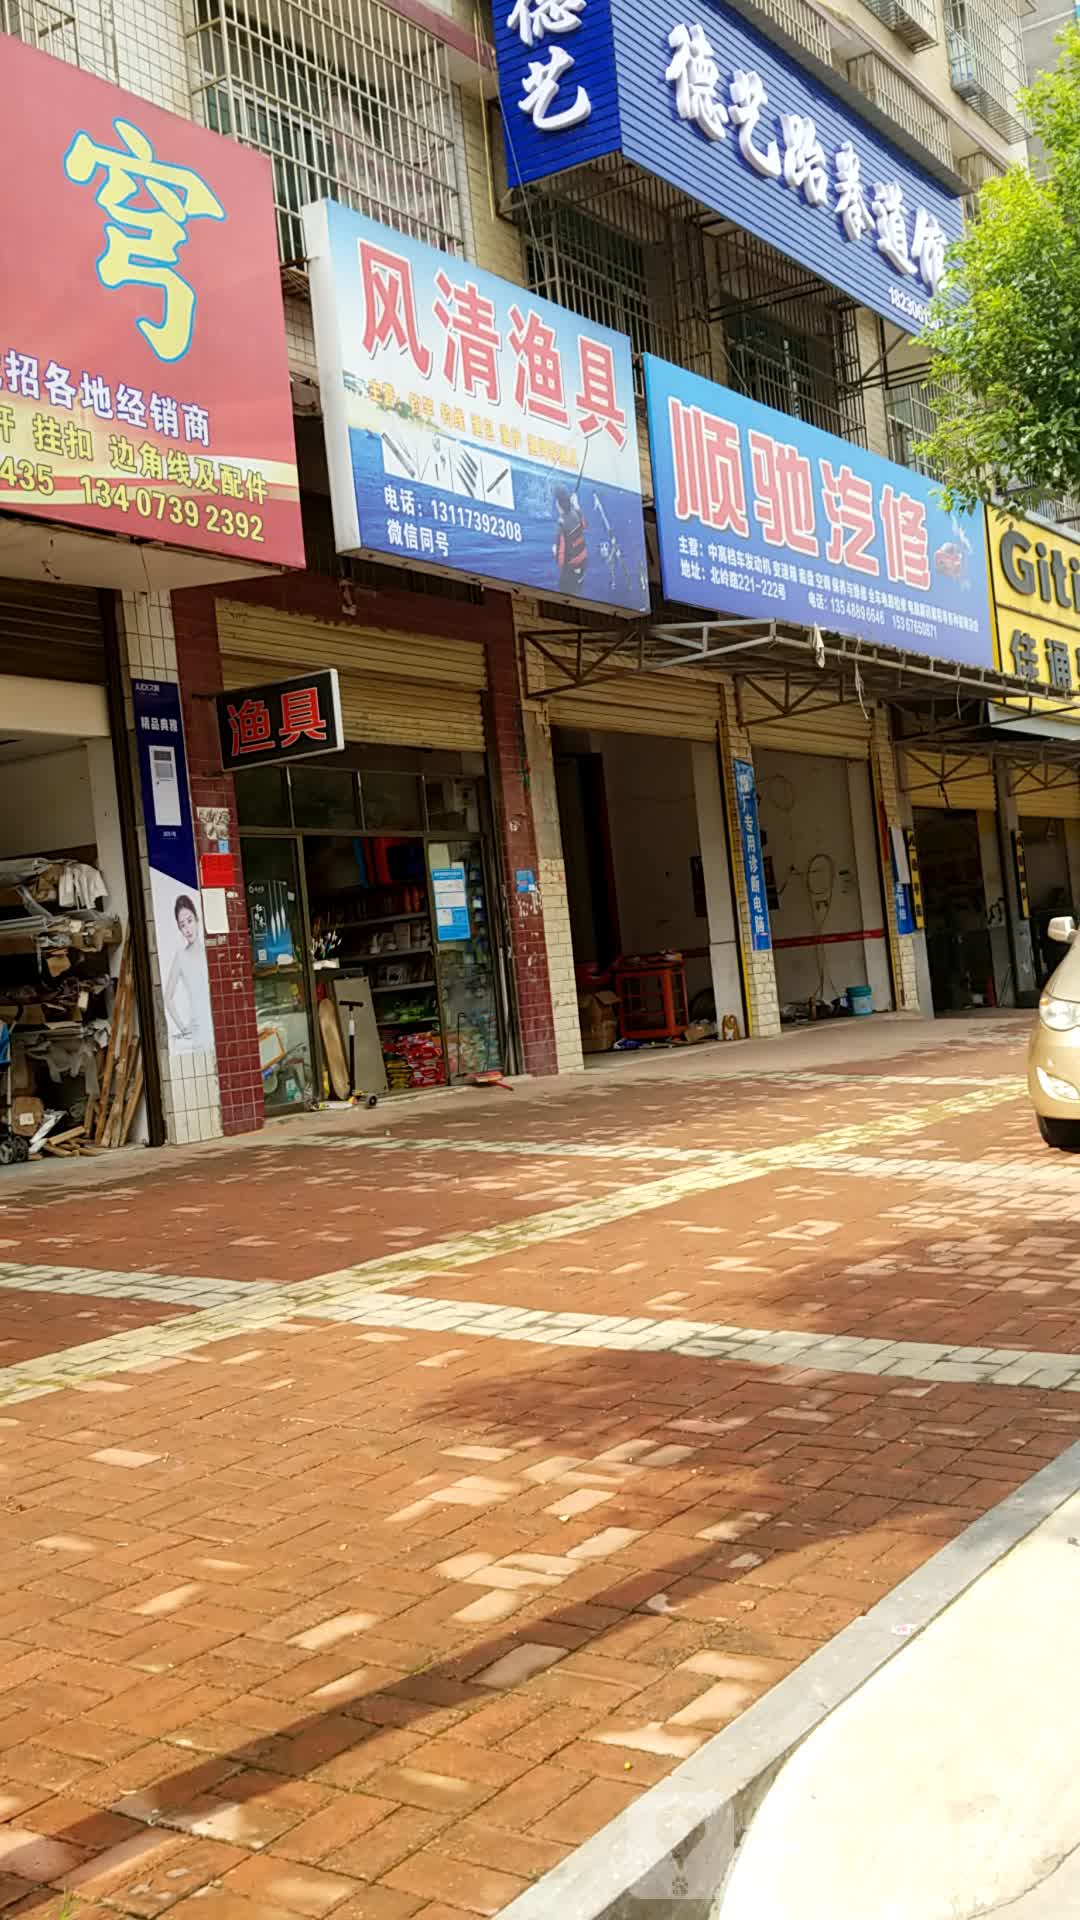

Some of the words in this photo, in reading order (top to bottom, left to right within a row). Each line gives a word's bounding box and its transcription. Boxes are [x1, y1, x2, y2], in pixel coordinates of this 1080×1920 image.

[63, 115, 228, 364] 穹
[357, 238, 628, 450] 风清渔具
[0, 346, 211, 447] 招各地经销商
[33, 413, 94, 461] 挂扣
[109, 434, 269, 505] 边角线及配件
[668, 396, 931, 592] 顺驰汽修
[80, 474, 130, 512] 134
[135, 487, 200, 529] 0739
[205, 504, 265, 543] 2392
[386, 518, 449, 558] 微信同号
[1010, 629, 1080, 689] 佳通
[226, 687, 327, 757] 渔具
